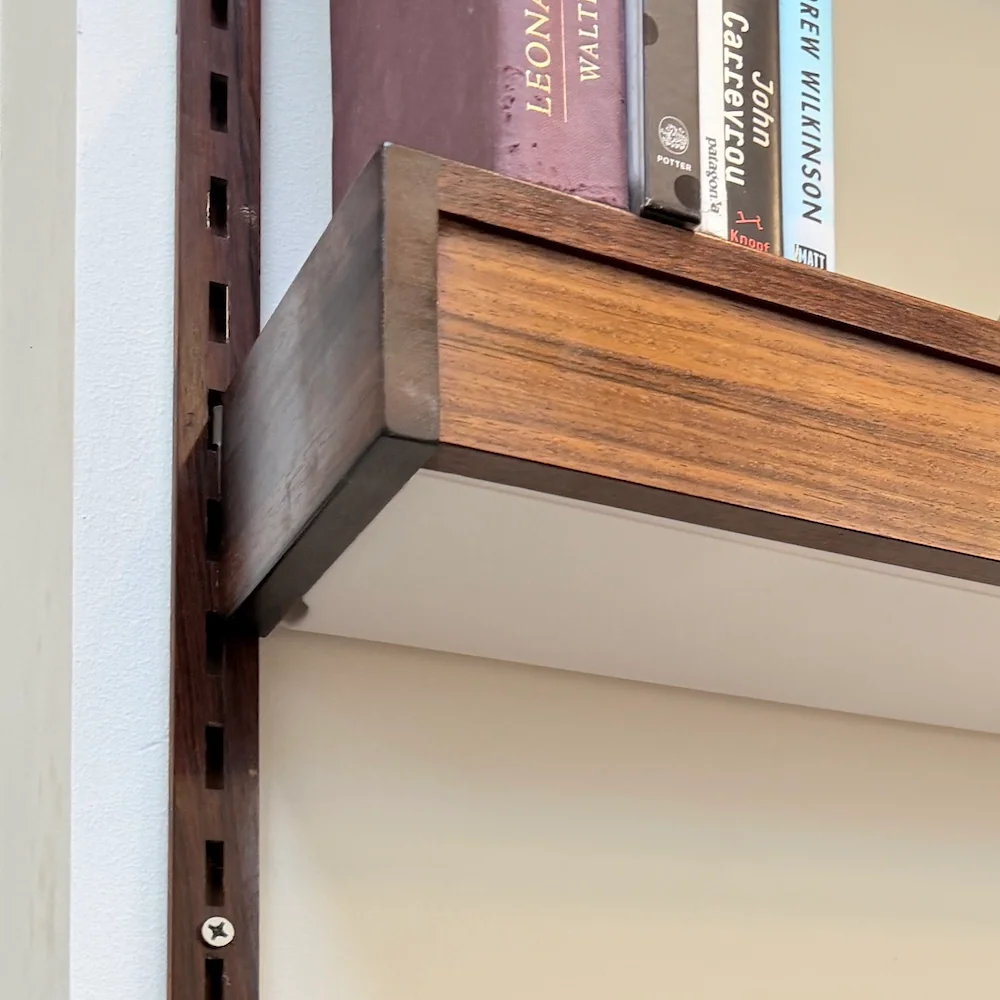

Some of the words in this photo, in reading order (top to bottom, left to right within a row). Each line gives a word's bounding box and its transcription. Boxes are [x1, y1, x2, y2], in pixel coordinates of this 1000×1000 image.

[800, 0, 820, 60] REW
[722, 11, 750, 186] Carreyrou
[751, 71, 775, 148] John
[656, 154, 692, 172] POTTER
[705, 136, 722, 214] patagona
[801, 70, 823, 224] WILKINSON
[730, 228, 771, 252] Knopf
